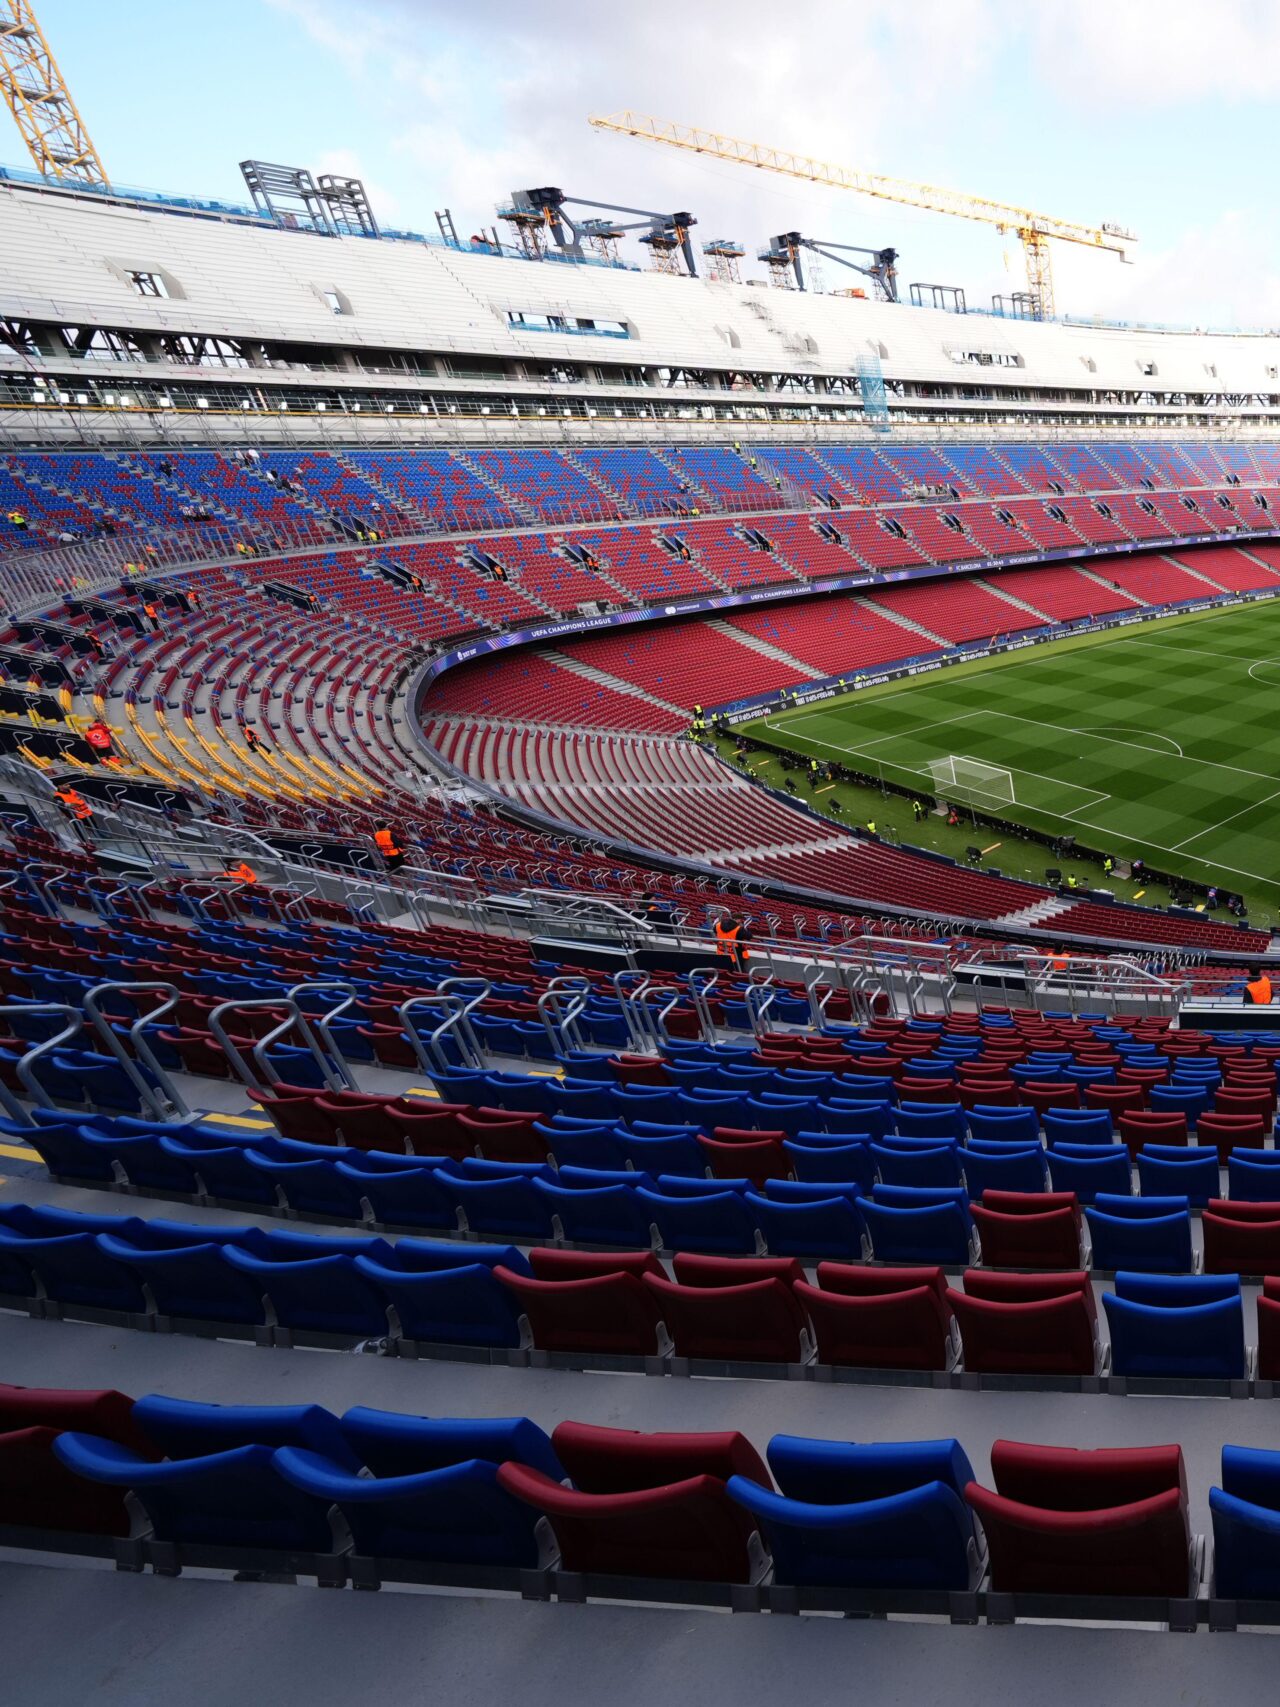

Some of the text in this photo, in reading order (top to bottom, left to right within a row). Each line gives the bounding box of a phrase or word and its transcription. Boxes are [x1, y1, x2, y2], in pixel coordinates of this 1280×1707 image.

[764, 589, 793, 599] CHAMPIONS
[793, 586, 811, 594] LEAGUE
[531, 617, 612, 638] UEFA CHAMPIONS LEAGUE
